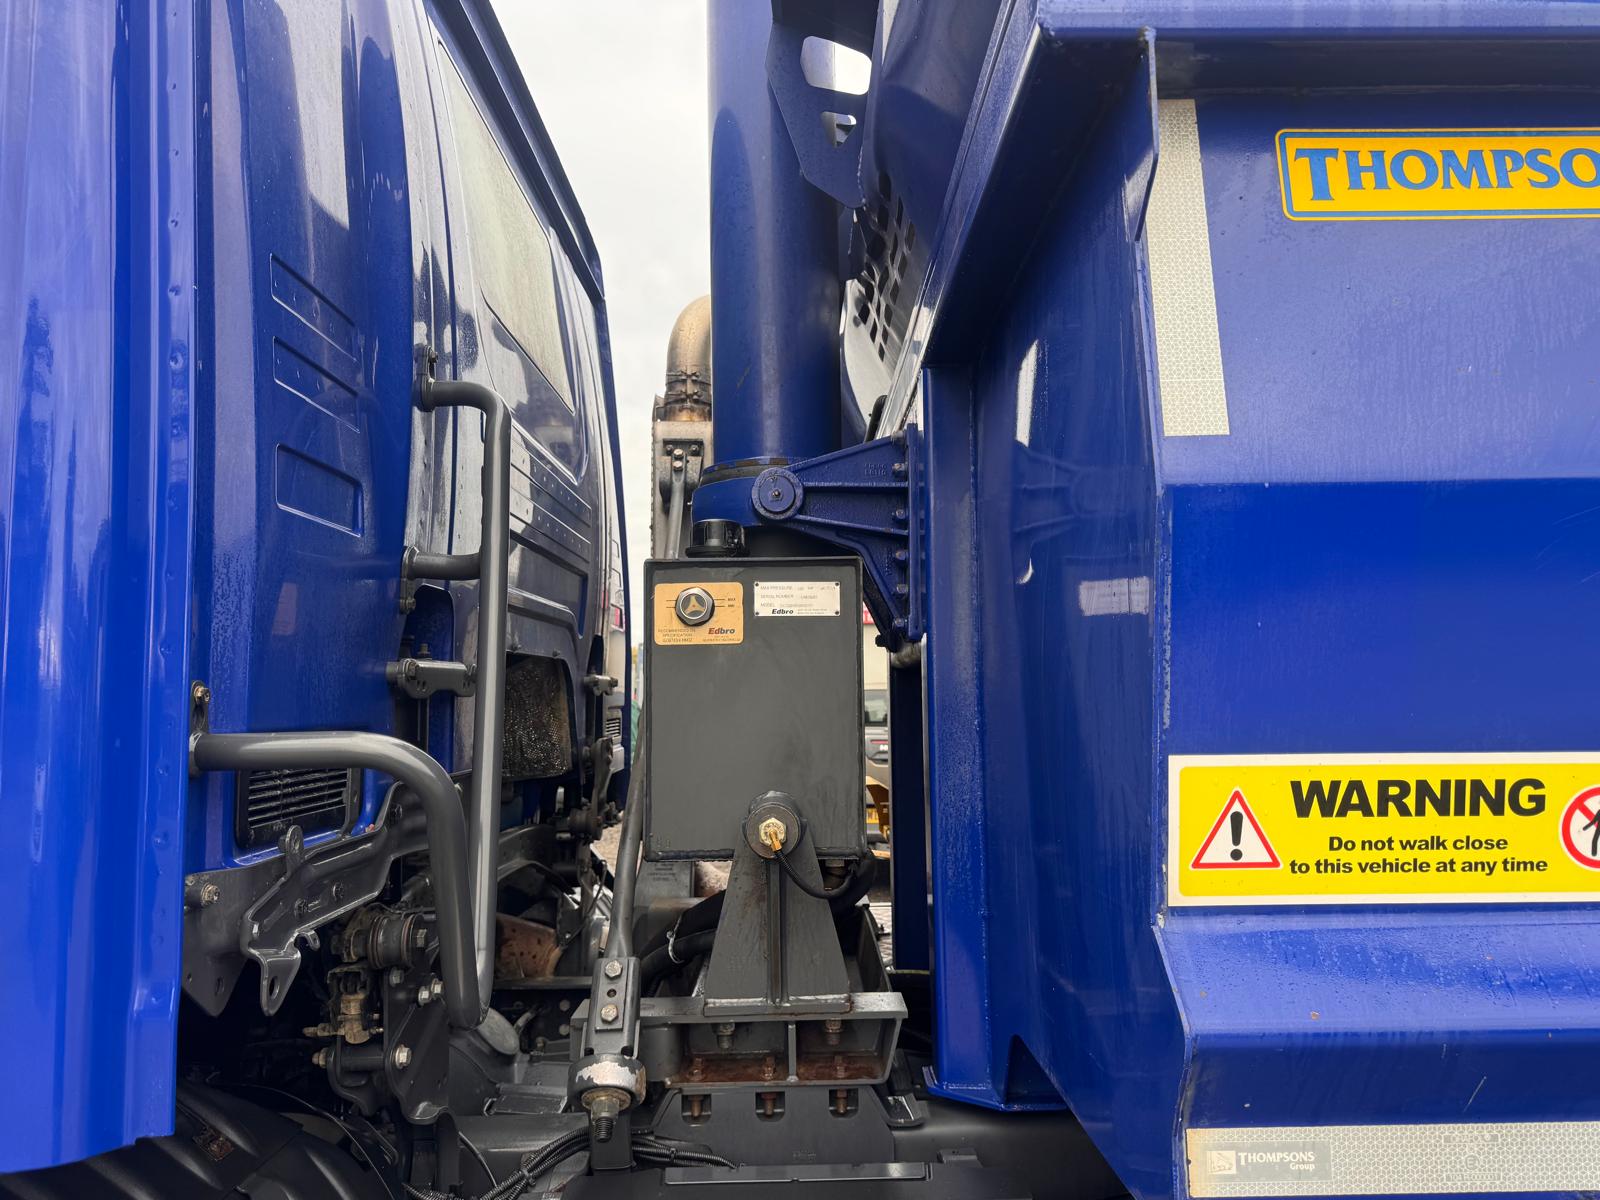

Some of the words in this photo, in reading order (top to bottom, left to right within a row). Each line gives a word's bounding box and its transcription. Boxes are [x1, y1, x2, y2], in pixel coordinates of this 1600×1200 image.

[708, 627, 736, 635] Edbro
[1290, 778, 1546, 818] WARNING
[1329, 837, 1356, 851] Do
[1361, 837, 1394, 851] not
[1399, 835, 1448, 850] walk
[1452, 835, 1508, 850] close
[1290, 860, 1311, 874] to
[1315, 858, 1354, 874] this
[1358, 857, 1431, 873] vehicle
[1435, 859, 1456, 873] at
[1461, 861, 1495, 876] any
[1502, 857, 1548, 872] time
[1238, 1151, 1315, 1166] THOMPSONS
[1289, 1162, 1315, 1172] Group
